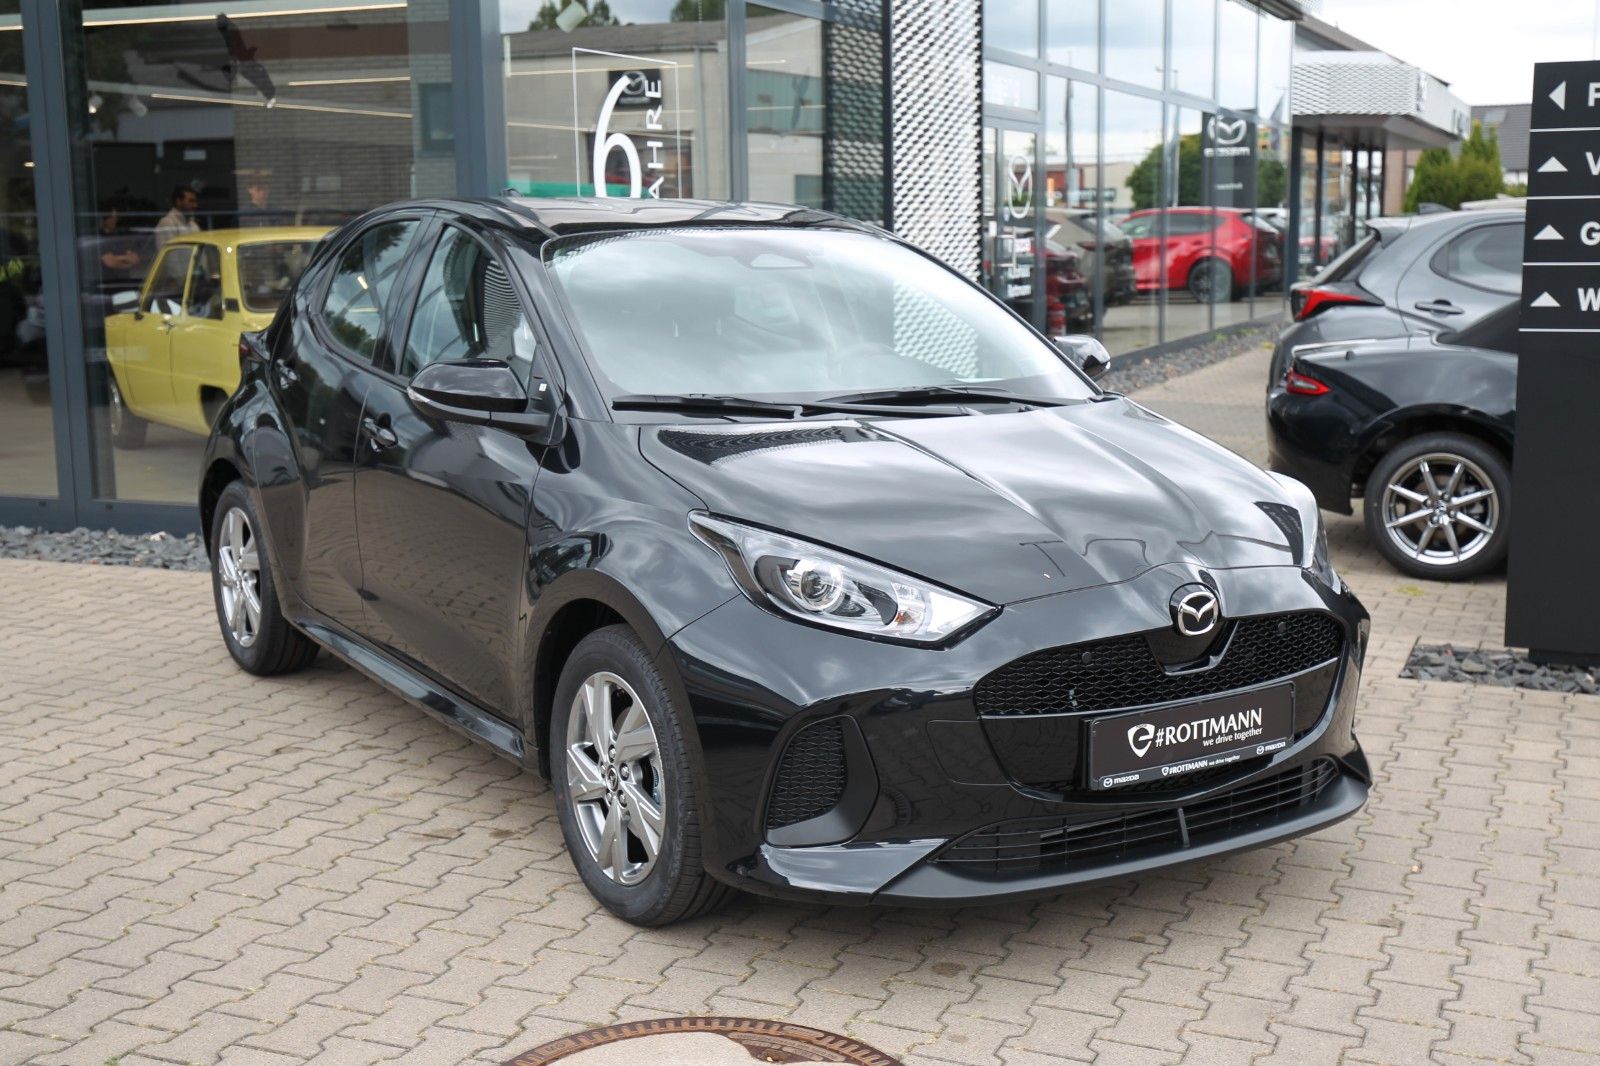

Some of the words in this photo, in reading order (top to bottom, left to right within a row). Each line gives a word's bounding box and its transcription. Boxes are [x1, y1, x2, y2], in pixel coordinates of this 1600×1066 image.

[1155, 707, 1262, 748] #ROTTMANN
[1202, 738, 1214, 747] we
[1215, 733, 1233, 745] drive
[1234, 727, 1263, 741] together
[1169, 760, 1208, 775] #ROTTMANN
[1224, 755, 1241, 763] together
